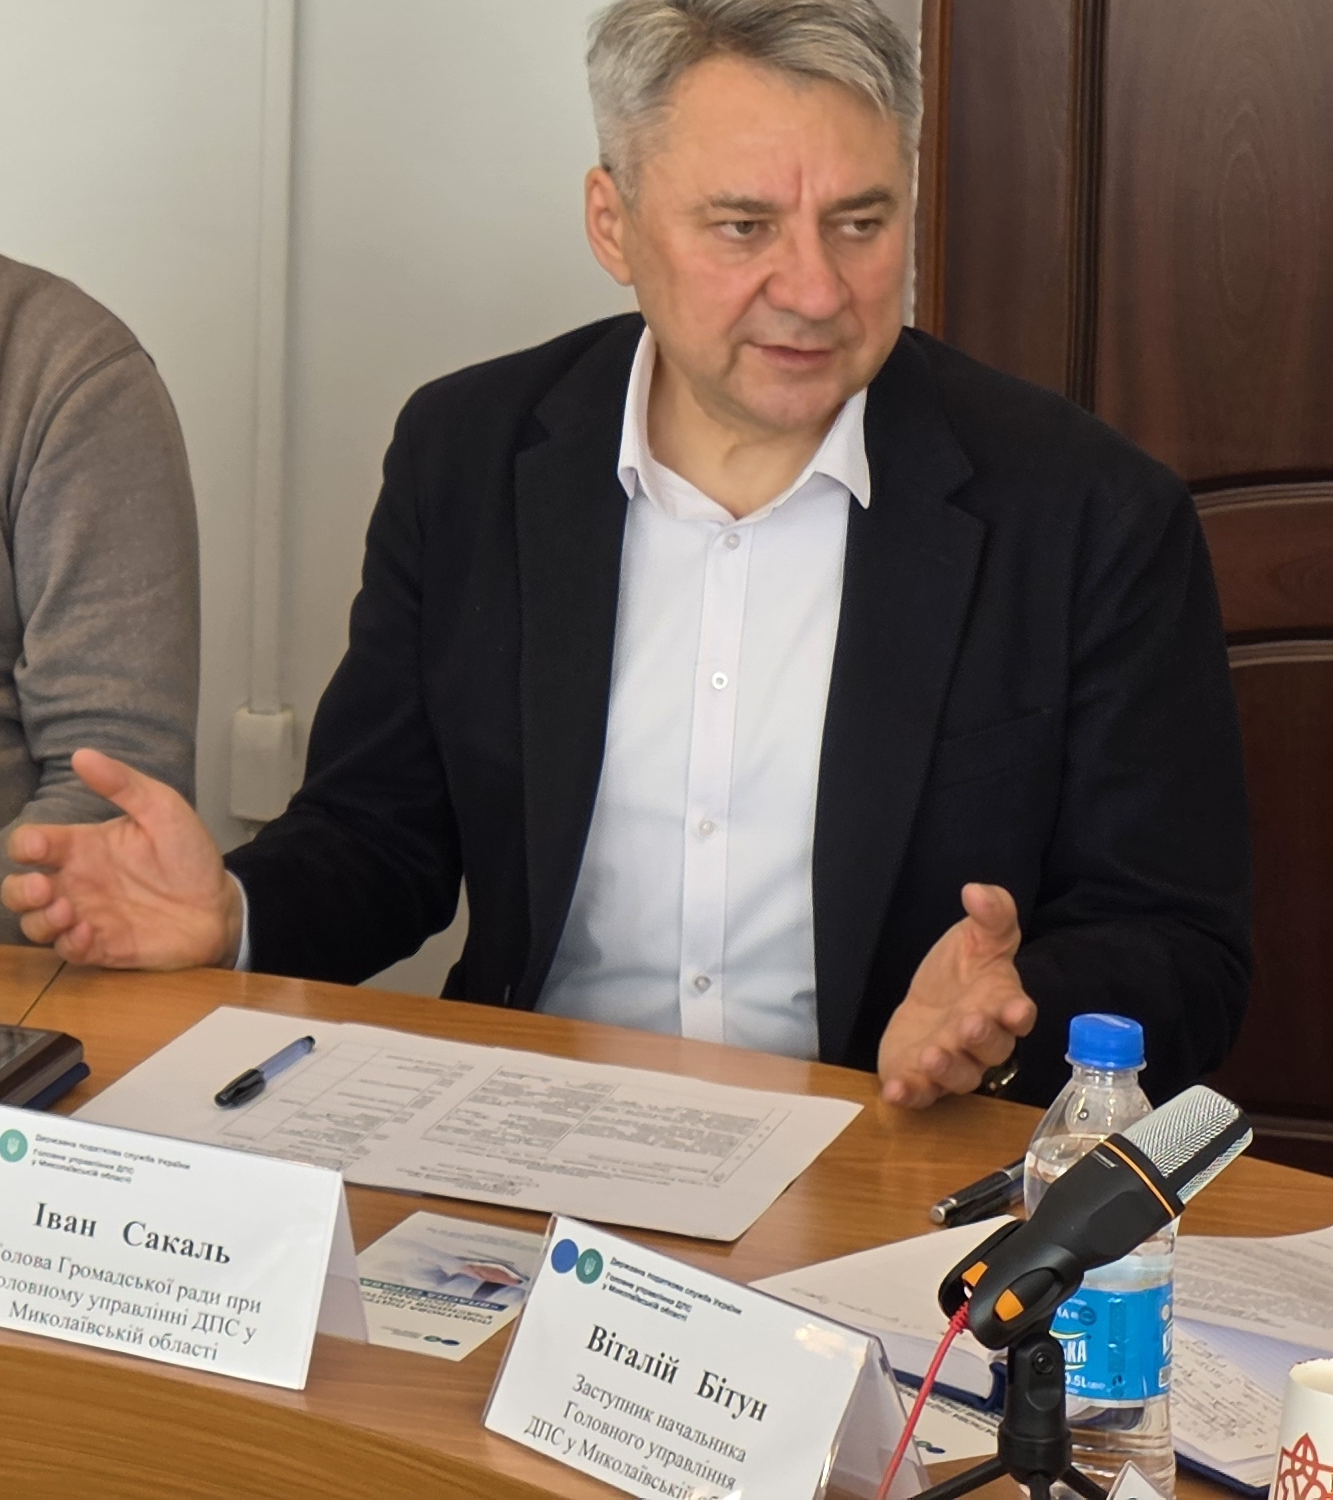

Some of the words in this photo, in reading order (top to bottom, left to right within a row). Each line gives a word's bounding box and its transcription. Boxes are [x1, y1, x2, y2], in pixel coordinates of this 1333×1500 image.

[33, 1202, 97, 1238] Іван
[123, 1221, 231, 1264] Сакаль
[58, 1256, 173, 1295] Громадської
[176, 1285, 220, 1305] ради
[227, 1295, 261, 1314] при
[9, 1300, 144, 1345] Миколаївській
[148, 1334, 219, 1361] області
[87, 1292, 189, 1326] управлінні
[192, 1312, 240, 1337] ДПС
[243, 1326, 257, 1344] у
[585, 1324, 679, 1385] Віталій
[694, 1370, 768, 1422] Бітун
[524, 1416, 565, 1446] ДПС
[563, 1436, 577, 1454] у
[564, 1401, 644, 1450] Головного
[644, 1441, 737, 1492] управління
[572, 1374, 654, 1423] Заступник
[656, 1414, 746, 1462] начальника
